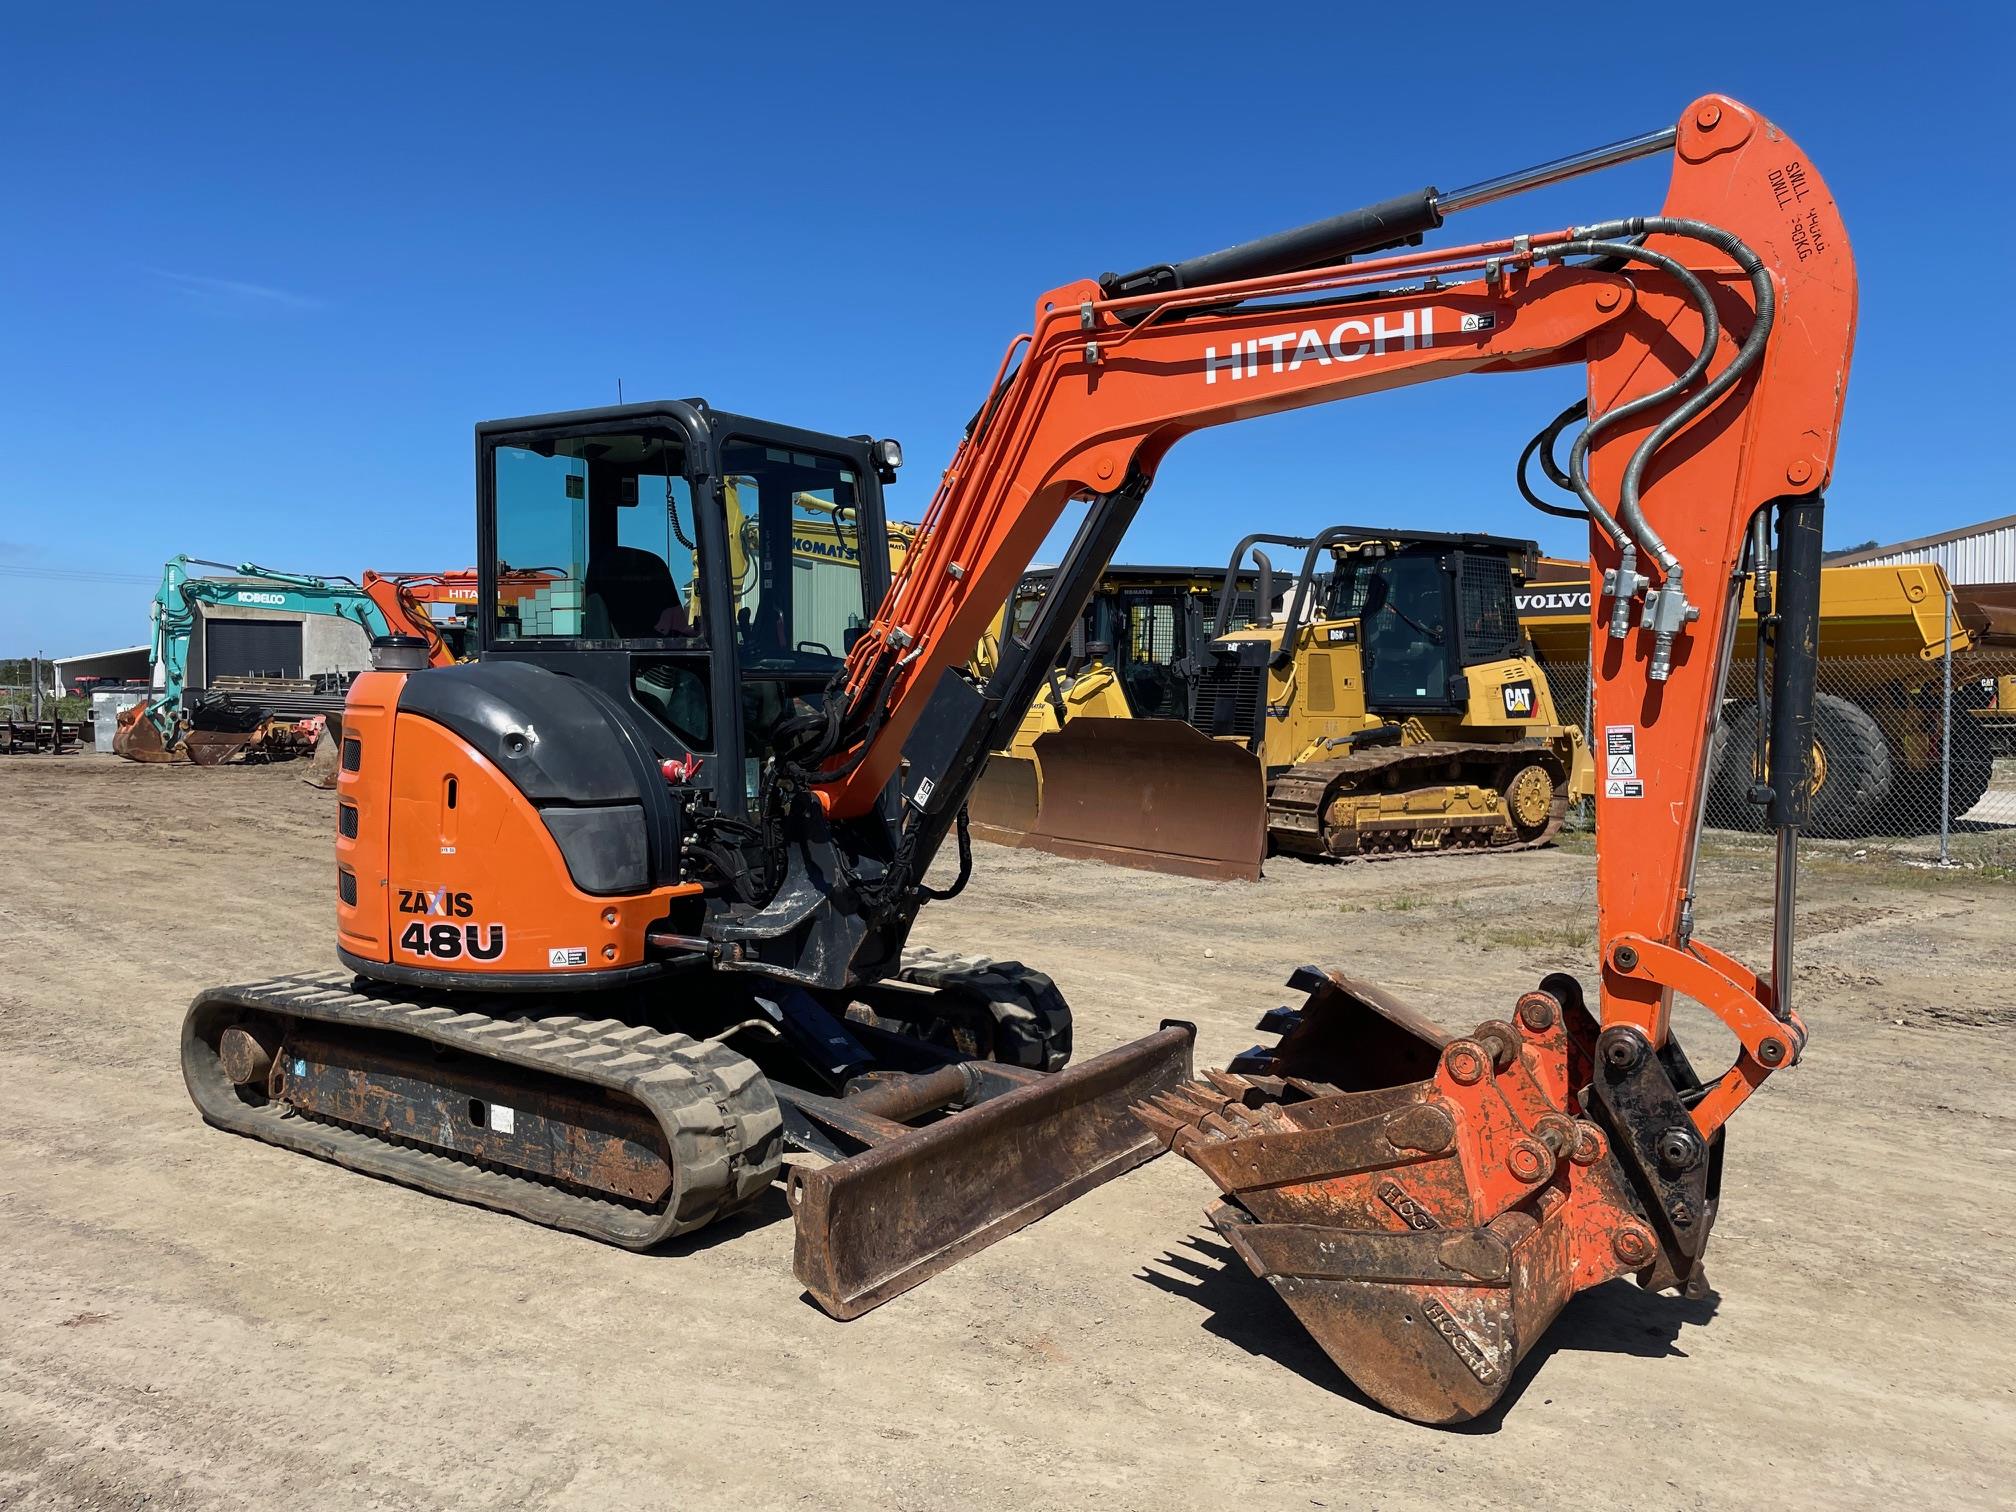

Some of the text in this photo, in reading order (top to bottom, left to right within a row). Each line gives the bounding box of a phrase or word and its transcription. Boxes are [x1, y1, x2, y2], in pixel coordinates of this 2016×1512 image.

[1205, 307, 1434, 385] HITACHI
[237, 591, 286, 605] KOBELCO
[448, 589, 501, 599] HITAI
[1514, 592, 1592, 610] VOLVO
[1981, 678, 1994, 687] CAT
[1504, 688, 1531, 712] CAT
[398, 885, 474, 918] ZAXIS
[400, 921, 505, 962] 48U
